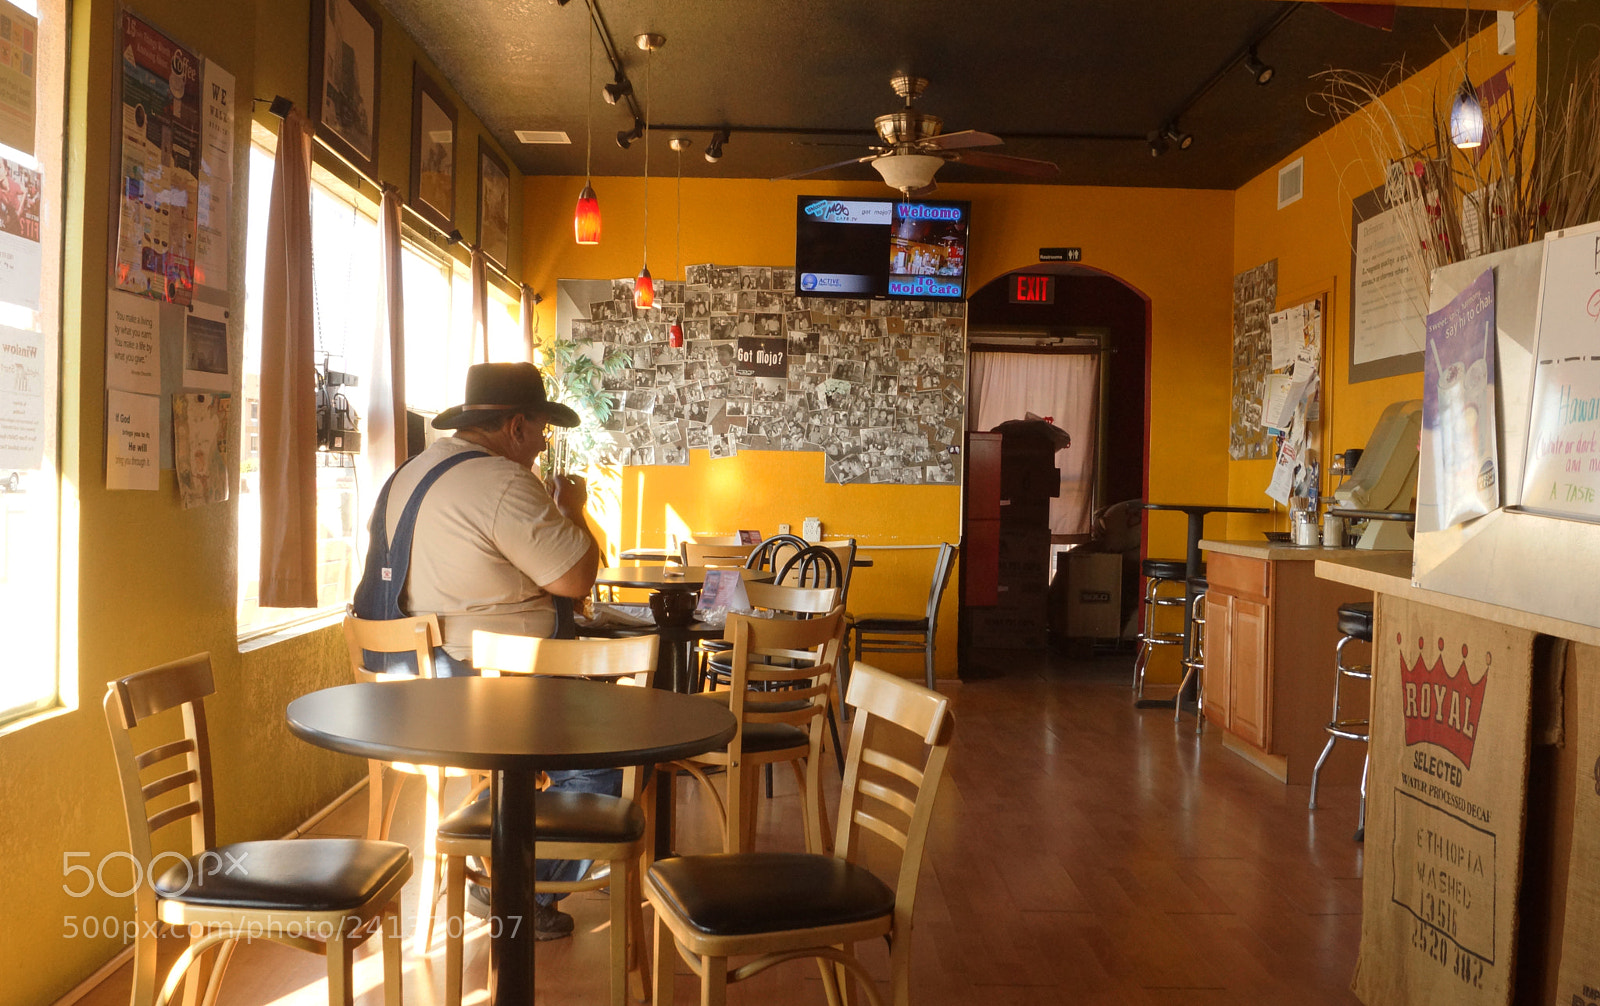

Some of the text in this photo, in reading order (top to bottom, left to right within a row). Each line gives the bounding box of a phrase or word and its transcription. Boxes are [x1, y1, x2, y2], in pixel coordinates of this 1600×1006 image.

[173, 48, 196, 81] Coffee
[212, 83, 226, 106] WE
[899, 204, 961, 219] Welcome
[891, 284, 959, 295] Mojo Cafe
[917, 277, 933, 286] To
[1017, 276, 1050, 302] EXIT
[1446, 291, 1493, 339] say hi to chai.
[132, 329, 140, 338] you
[738, 348, 783, 366] Got Mojo?
[120, 413, 131, 424] God
[128, 441, 148, 452] He will
[1565, 441, 1575, 454] or
[1576, 430, 1597, 454] dark
[1566, 457, 1581, 472] and
[1550, 480, 1595, 503] A TASTE
[1405, 681, 1474, 740] ROYAL
[1413, 750, 1463, 788] SELECTED
[1401, 772, 1492, 823] WATER PROCESSED DECAF
[1417, 828, 1485, 878] ETHIOPIA
[1417, 861, 1472, 910] WASHED
